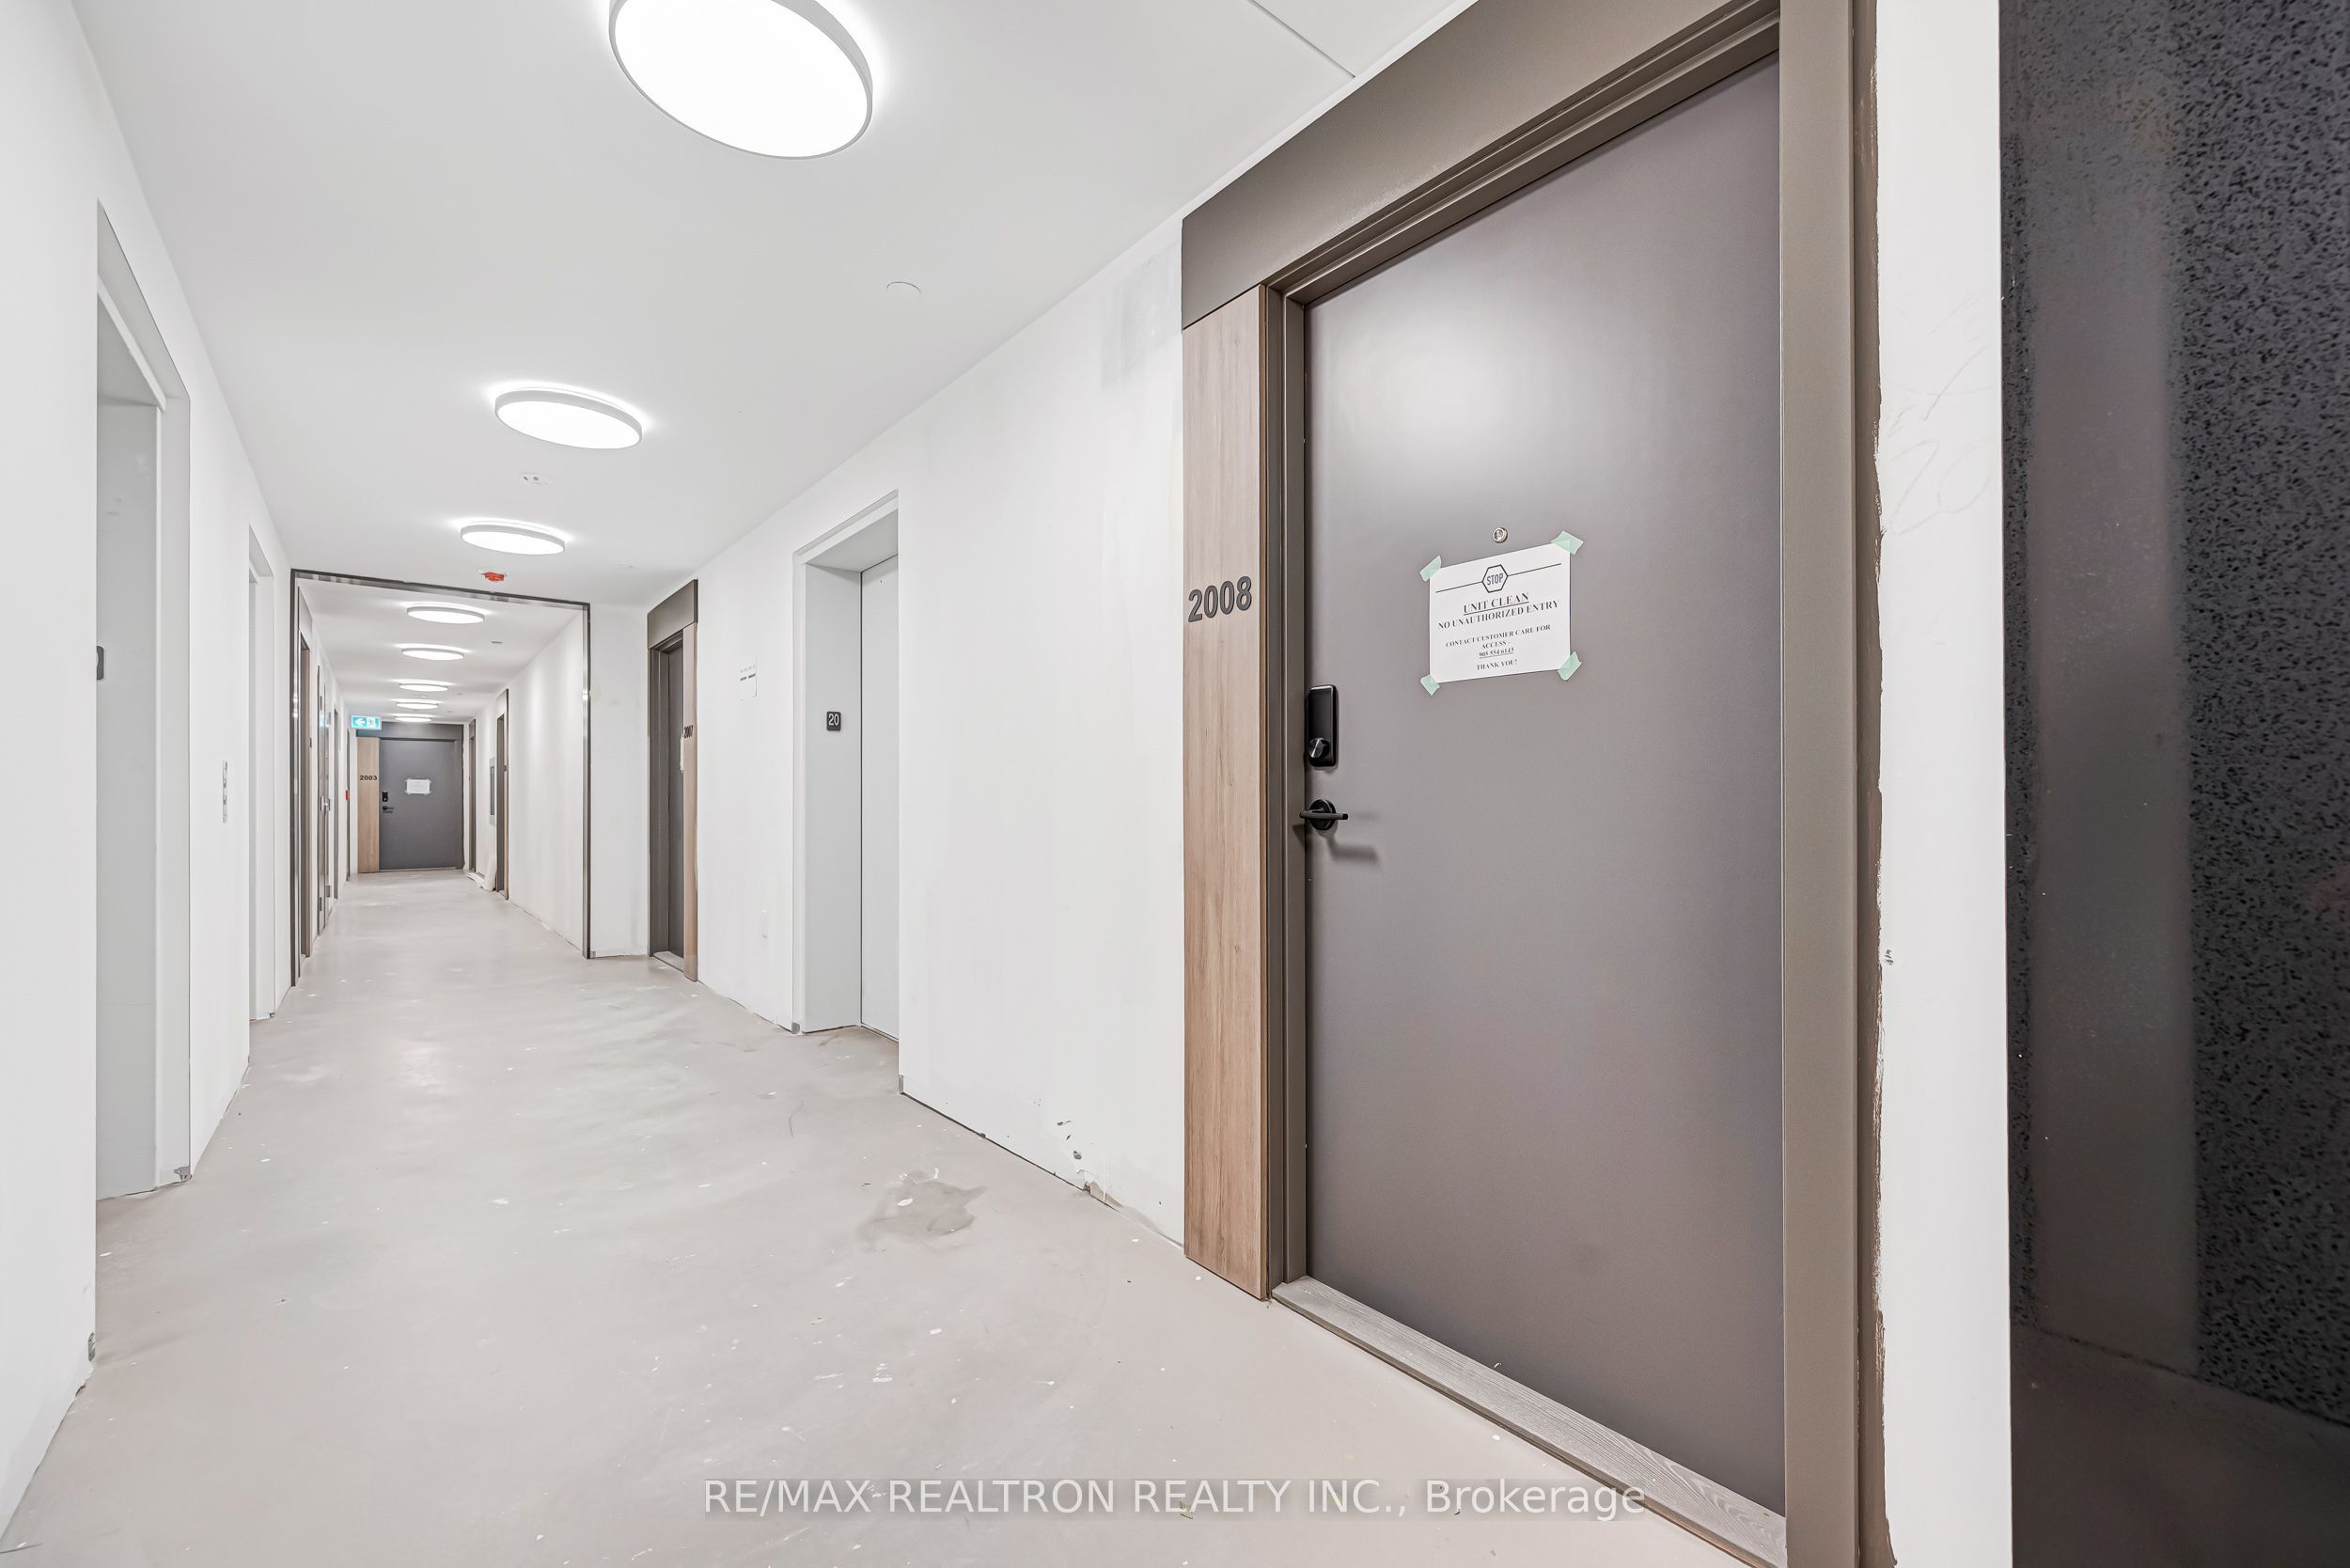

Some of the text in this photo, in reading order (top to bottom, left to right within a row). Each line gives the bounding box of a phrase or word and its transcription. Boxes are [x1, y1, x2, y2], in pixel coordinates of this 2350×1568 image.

[1486, 572, 1504, 586] STOP
[1187, 575, 1252, 622] 2008
[1464, 592, 1529, 613] UNIT CLEAN
[1437, 599, 1559, 630] NO UNAUTHORIZED ENTRY
[1445, 624, 1551, 648] CONTACT CUSTOMER CARE FOR
[1481, 640, 1507, 650] ACCESS
[1477, 662, 1499, 670] THANK
[828, 713, 840, 726] 20
